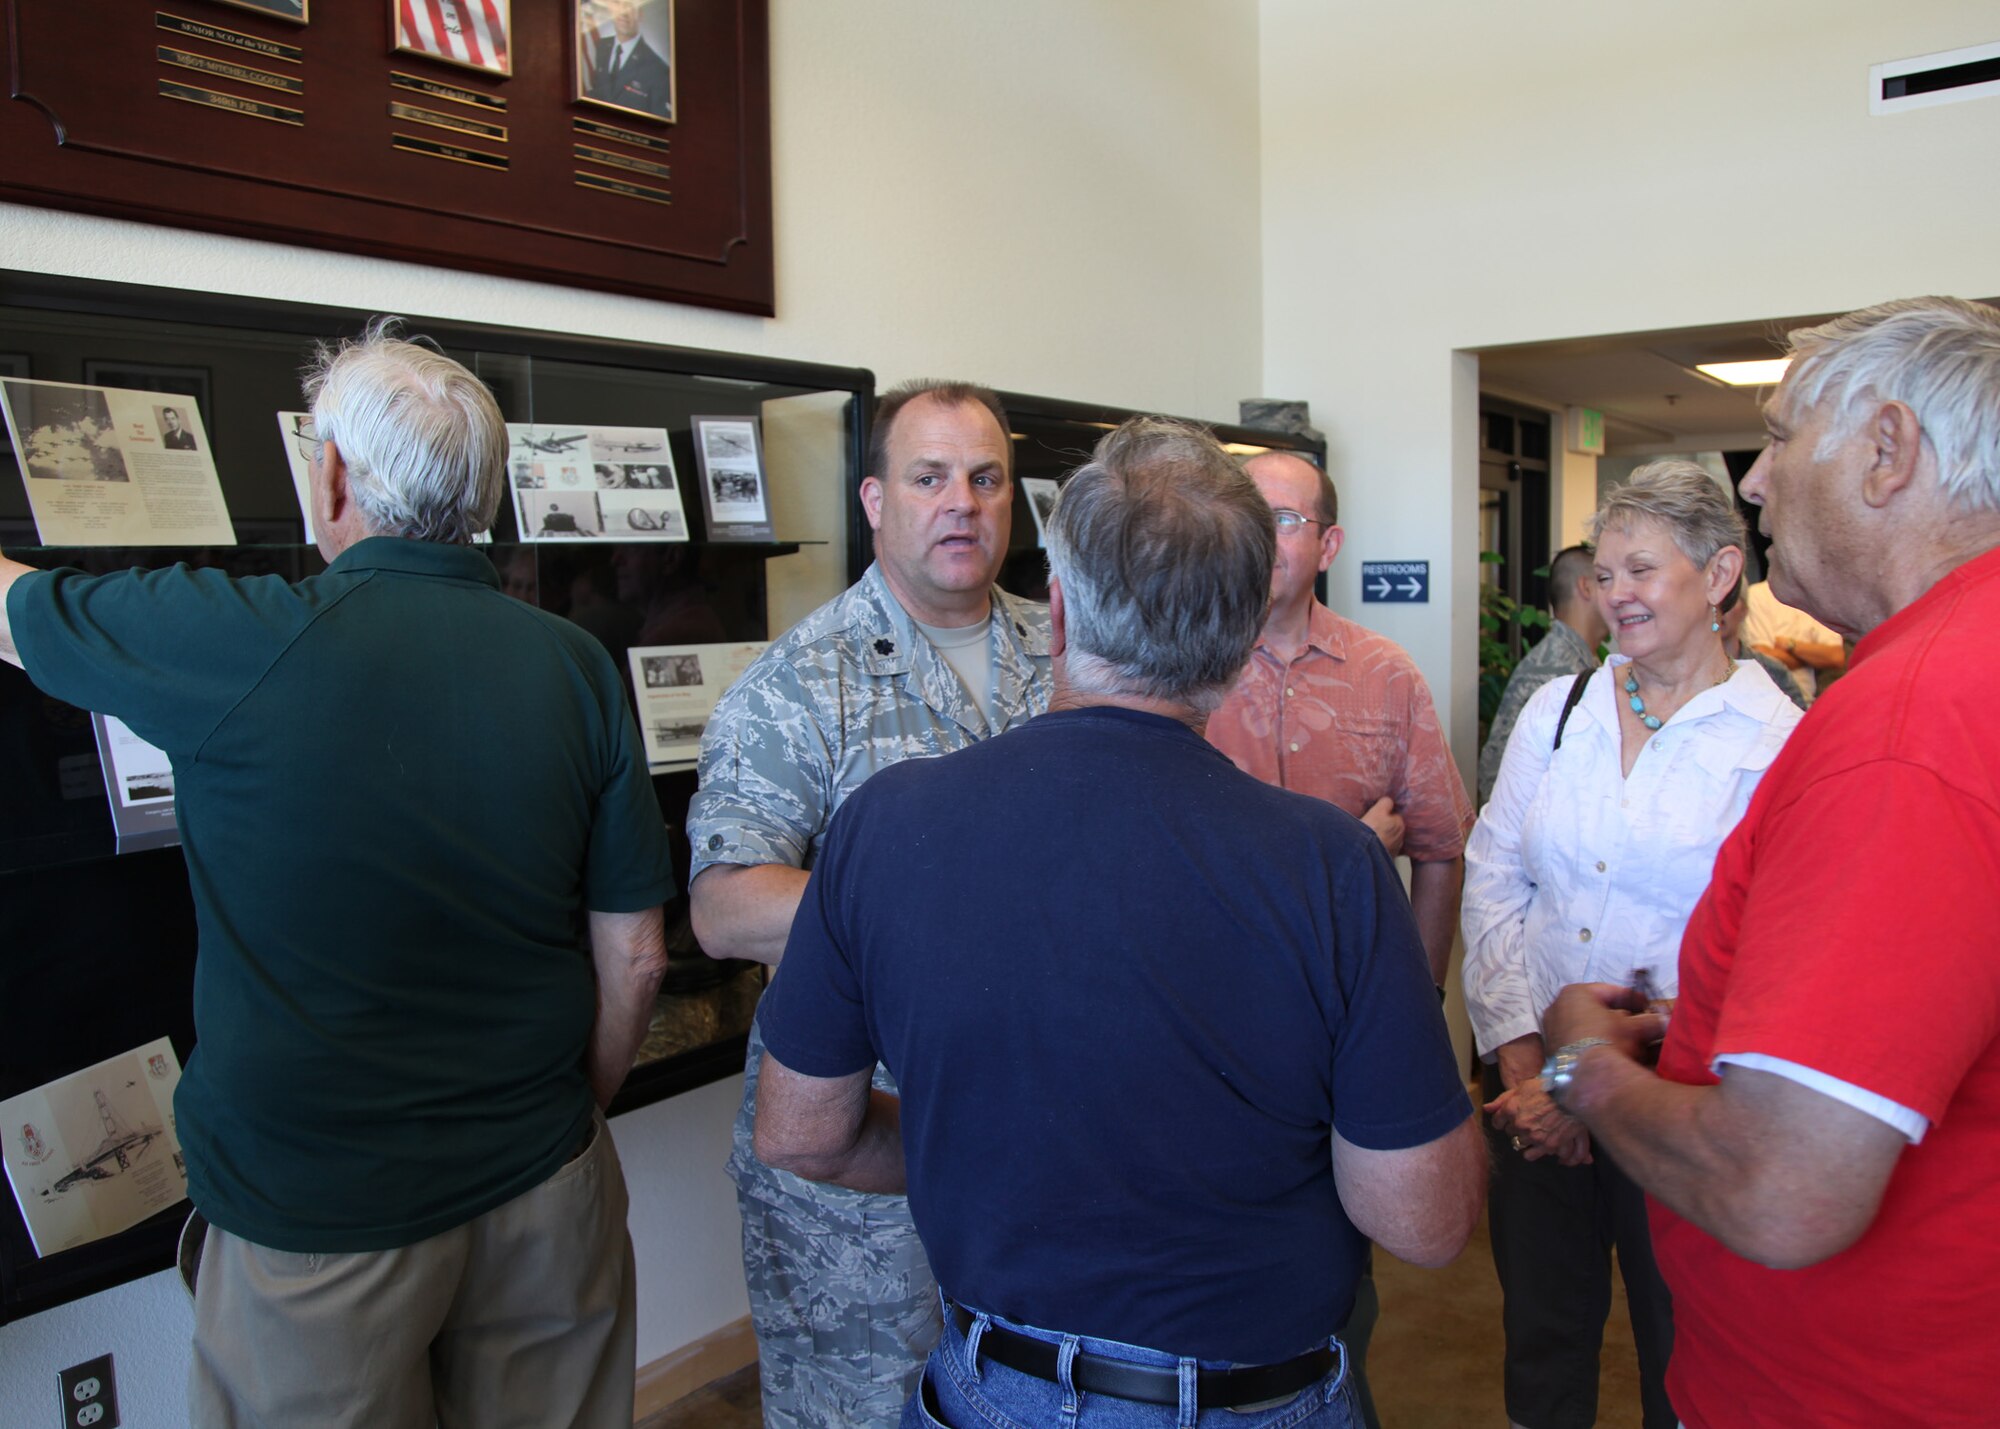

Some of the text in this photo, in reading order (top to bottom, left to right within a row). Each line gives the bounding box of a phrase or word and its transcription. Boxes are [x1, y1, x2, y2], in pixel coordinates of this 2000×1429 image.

[181, 22, 215, 38] SENIOR
[235, 36, 244, 44] of
[244, 40, 256, 48] the
[255, 42, 281, 55] YEAR
[249, 72, 288, 87] COOPER
[1363, 563, 1427, 575] RESTROOMS
